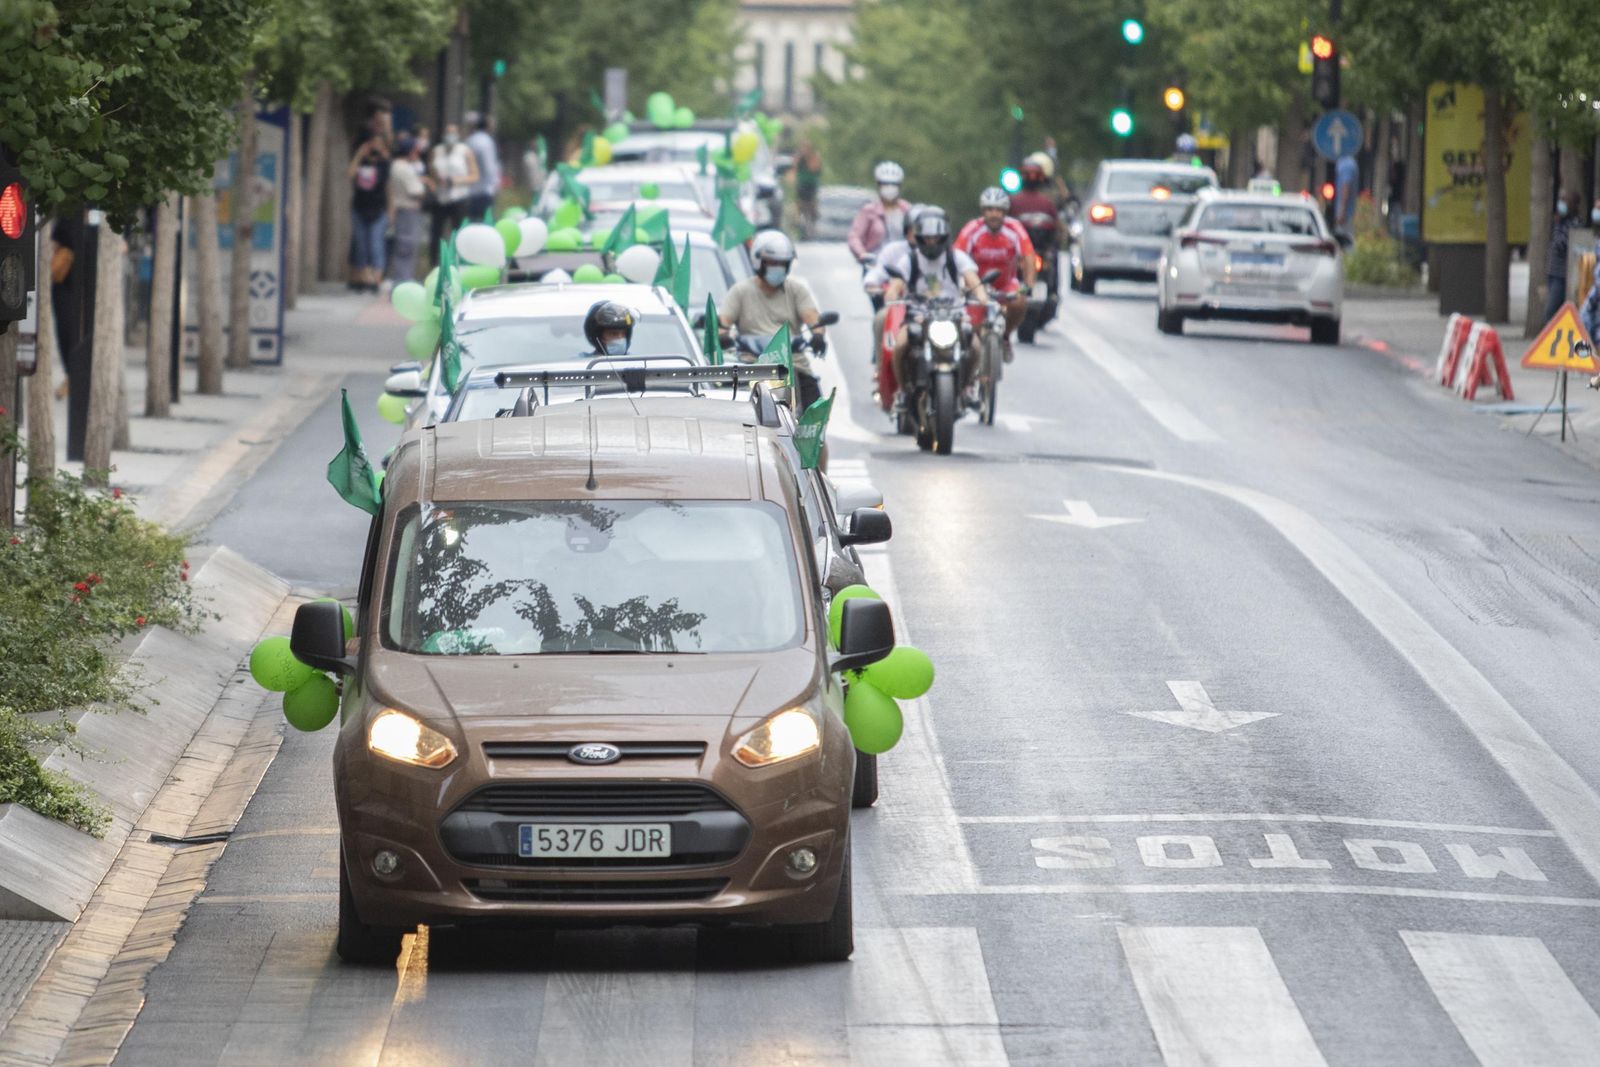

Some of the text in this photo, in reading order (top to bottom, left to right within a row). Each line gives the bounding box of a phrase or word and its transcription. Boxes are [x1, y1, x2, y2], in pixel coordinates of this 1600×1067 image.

[1442, 150, 1479, 167] GET
[1452, 173, 1484, 186] NO
[580, 746, 609, 759] Ford
[538, 828, 604, 852] 5376
[615, 828, 663, 852] JDR
[1030, 833, 1550, 882] MOTOS
